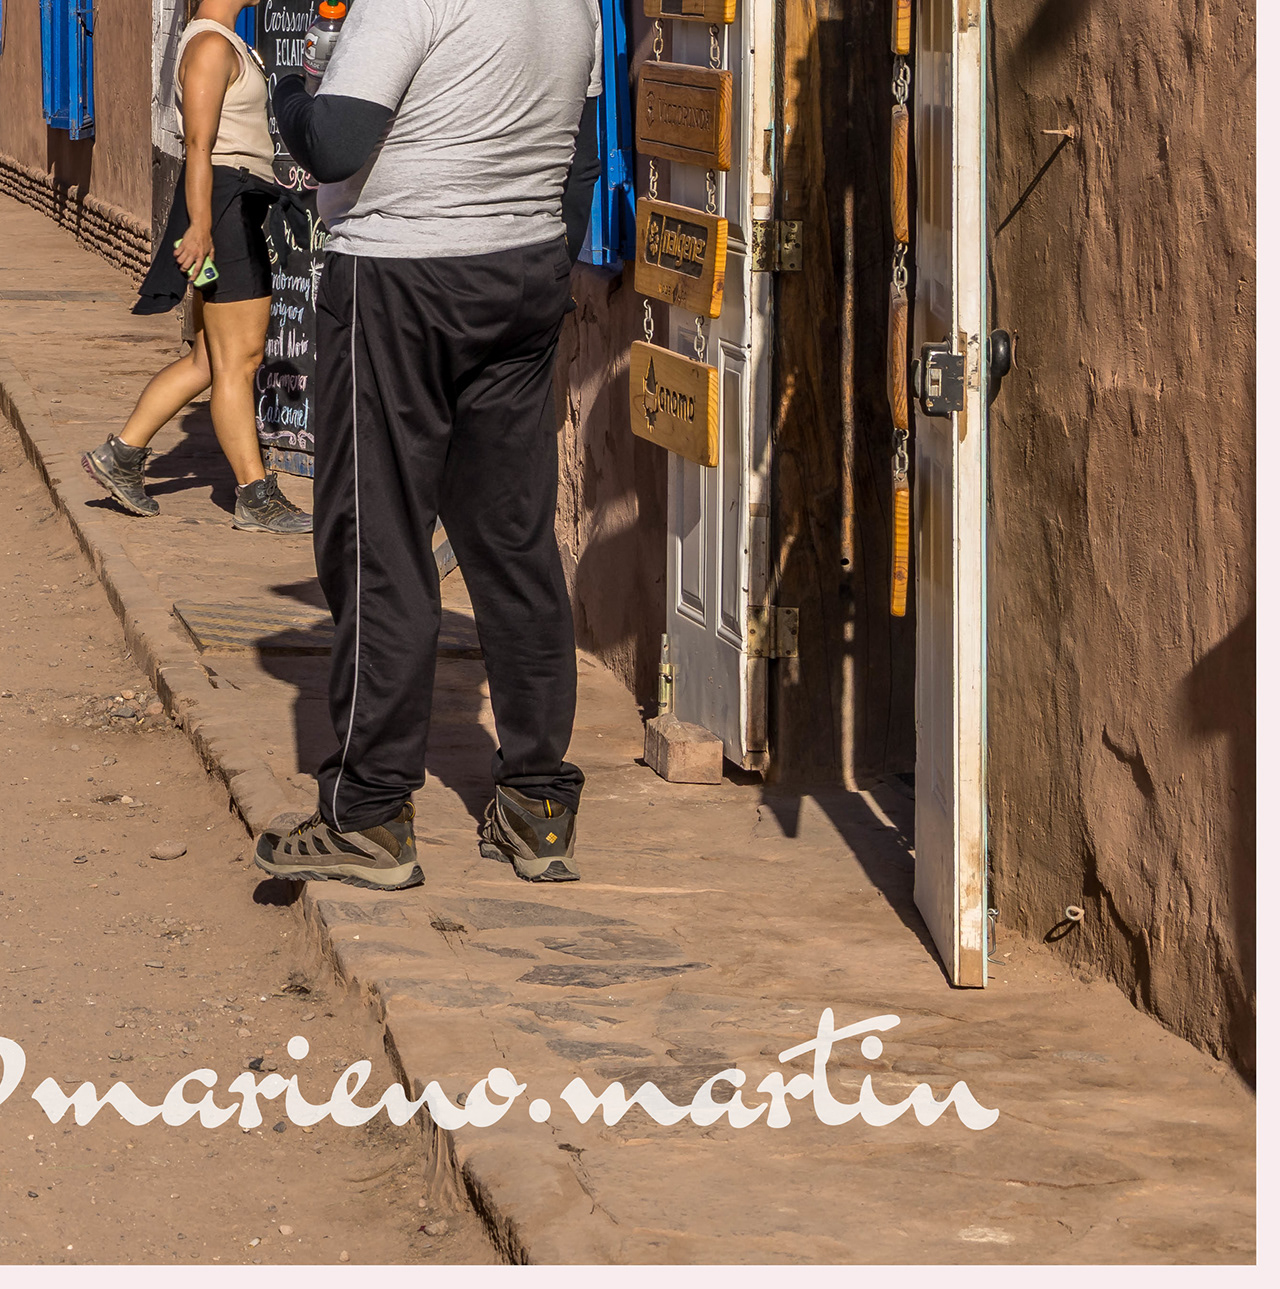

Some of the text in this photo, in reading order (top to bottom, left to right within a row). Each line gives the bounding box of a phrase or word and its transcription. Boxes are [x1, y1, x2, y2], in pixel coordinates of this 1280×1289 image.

[657, 96, 710, 132] VICTORINOX
[661, 224, 706, 268] nalgene
[271, 265, 311, 302] rdonnay
[270, 297, 305, 328] uvignon
[265, 327, 284, 360] inot
[258, 393, 311, 432] Cabernet
